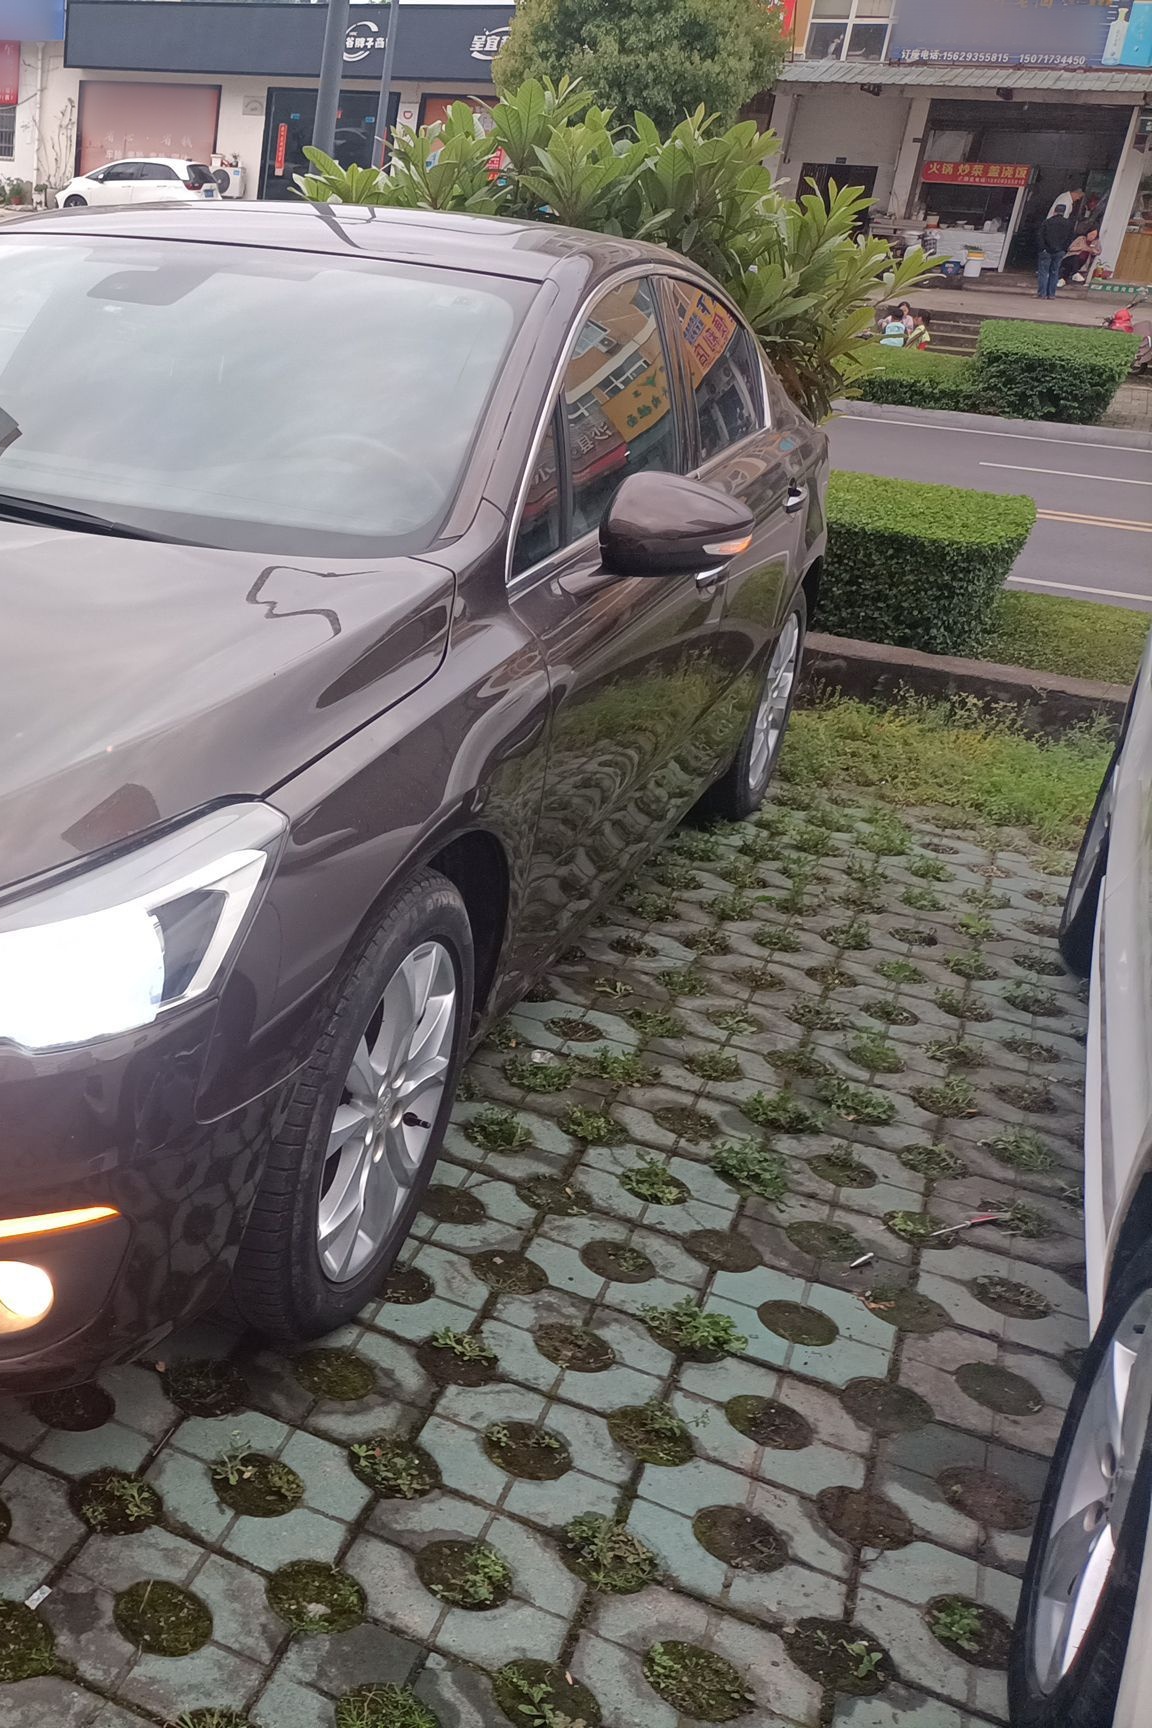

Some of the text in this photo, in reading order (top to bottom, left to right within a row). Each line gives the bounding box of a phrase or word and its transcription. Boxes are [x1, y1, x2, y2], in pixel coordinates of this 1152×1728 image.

[1018, 54, 1086, 65] 15071734450
[928, 163, 954, 175] 火锅
[957, 164, 985, 177] 炒菜
